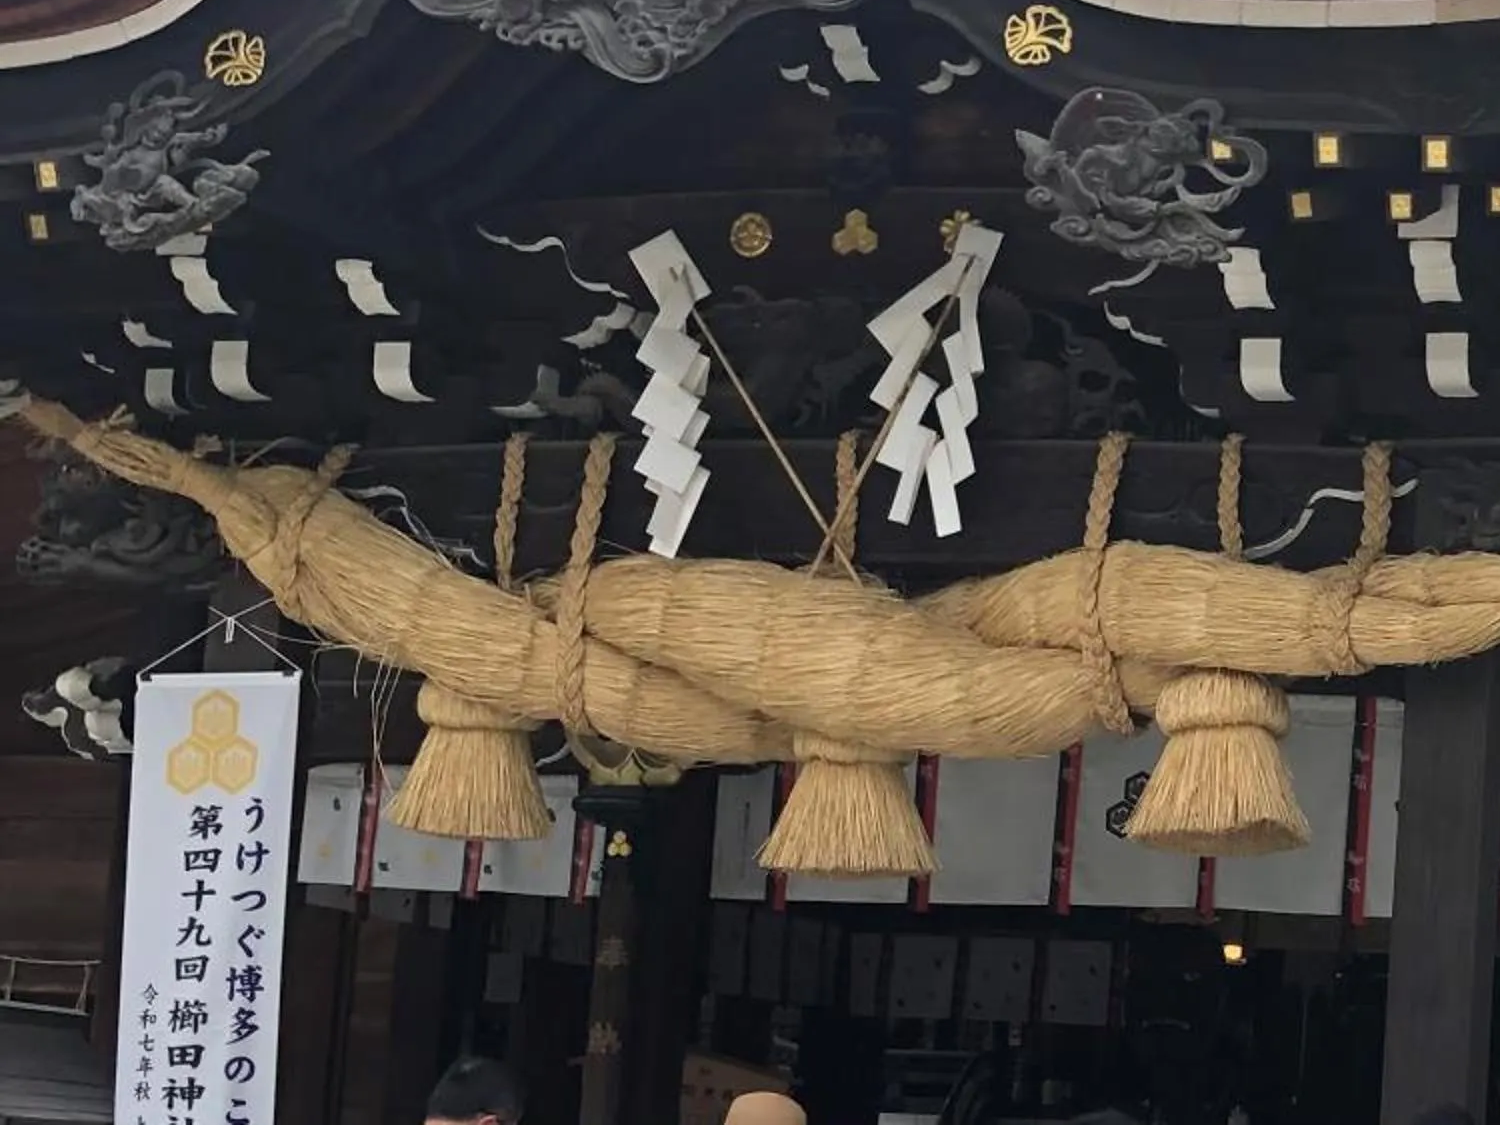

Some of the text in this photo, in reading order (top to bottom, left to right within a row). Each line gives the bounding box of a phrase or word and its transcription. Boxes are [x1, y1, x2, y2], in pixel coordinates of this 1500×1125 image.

[224, 797, 270, 1125] うけつぐ博多のこ
